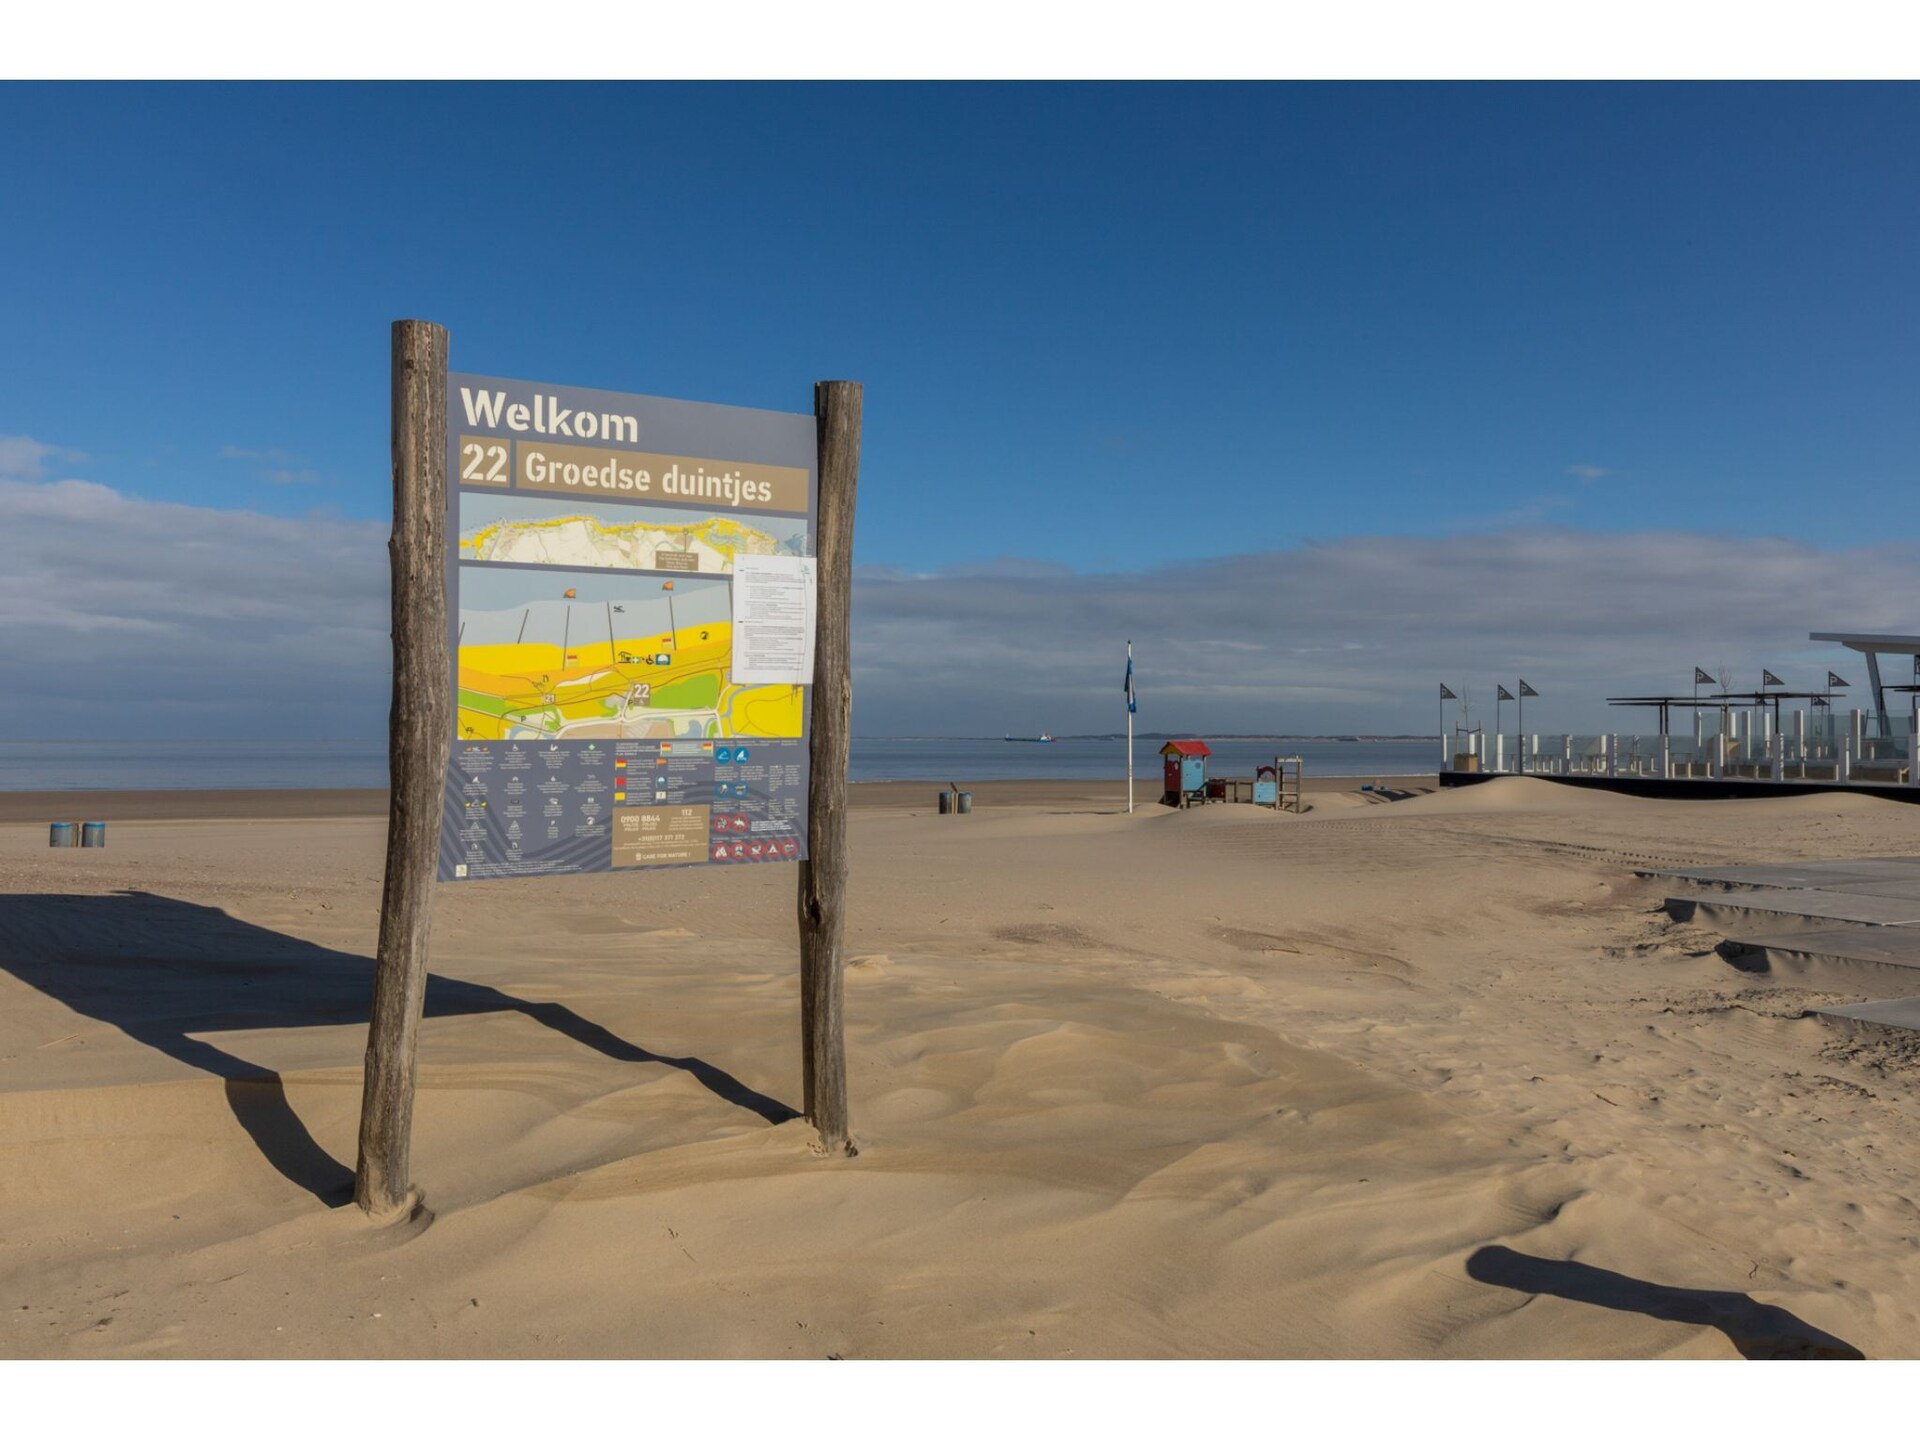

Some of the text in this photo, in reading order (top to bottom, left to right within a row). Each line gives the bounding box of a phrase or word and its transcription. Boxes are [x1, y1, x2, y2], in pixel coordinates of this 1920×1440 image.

[460, 387, 639, 443] Welkom
[462, 443, 773, 507] 22 Groedse duintjes
[634, 684, 650, 698] 22
[545, 694, 555, 703] 21
[681, 808, 693, 816] 112
[620, 814, 661, 823] 0900 8844
